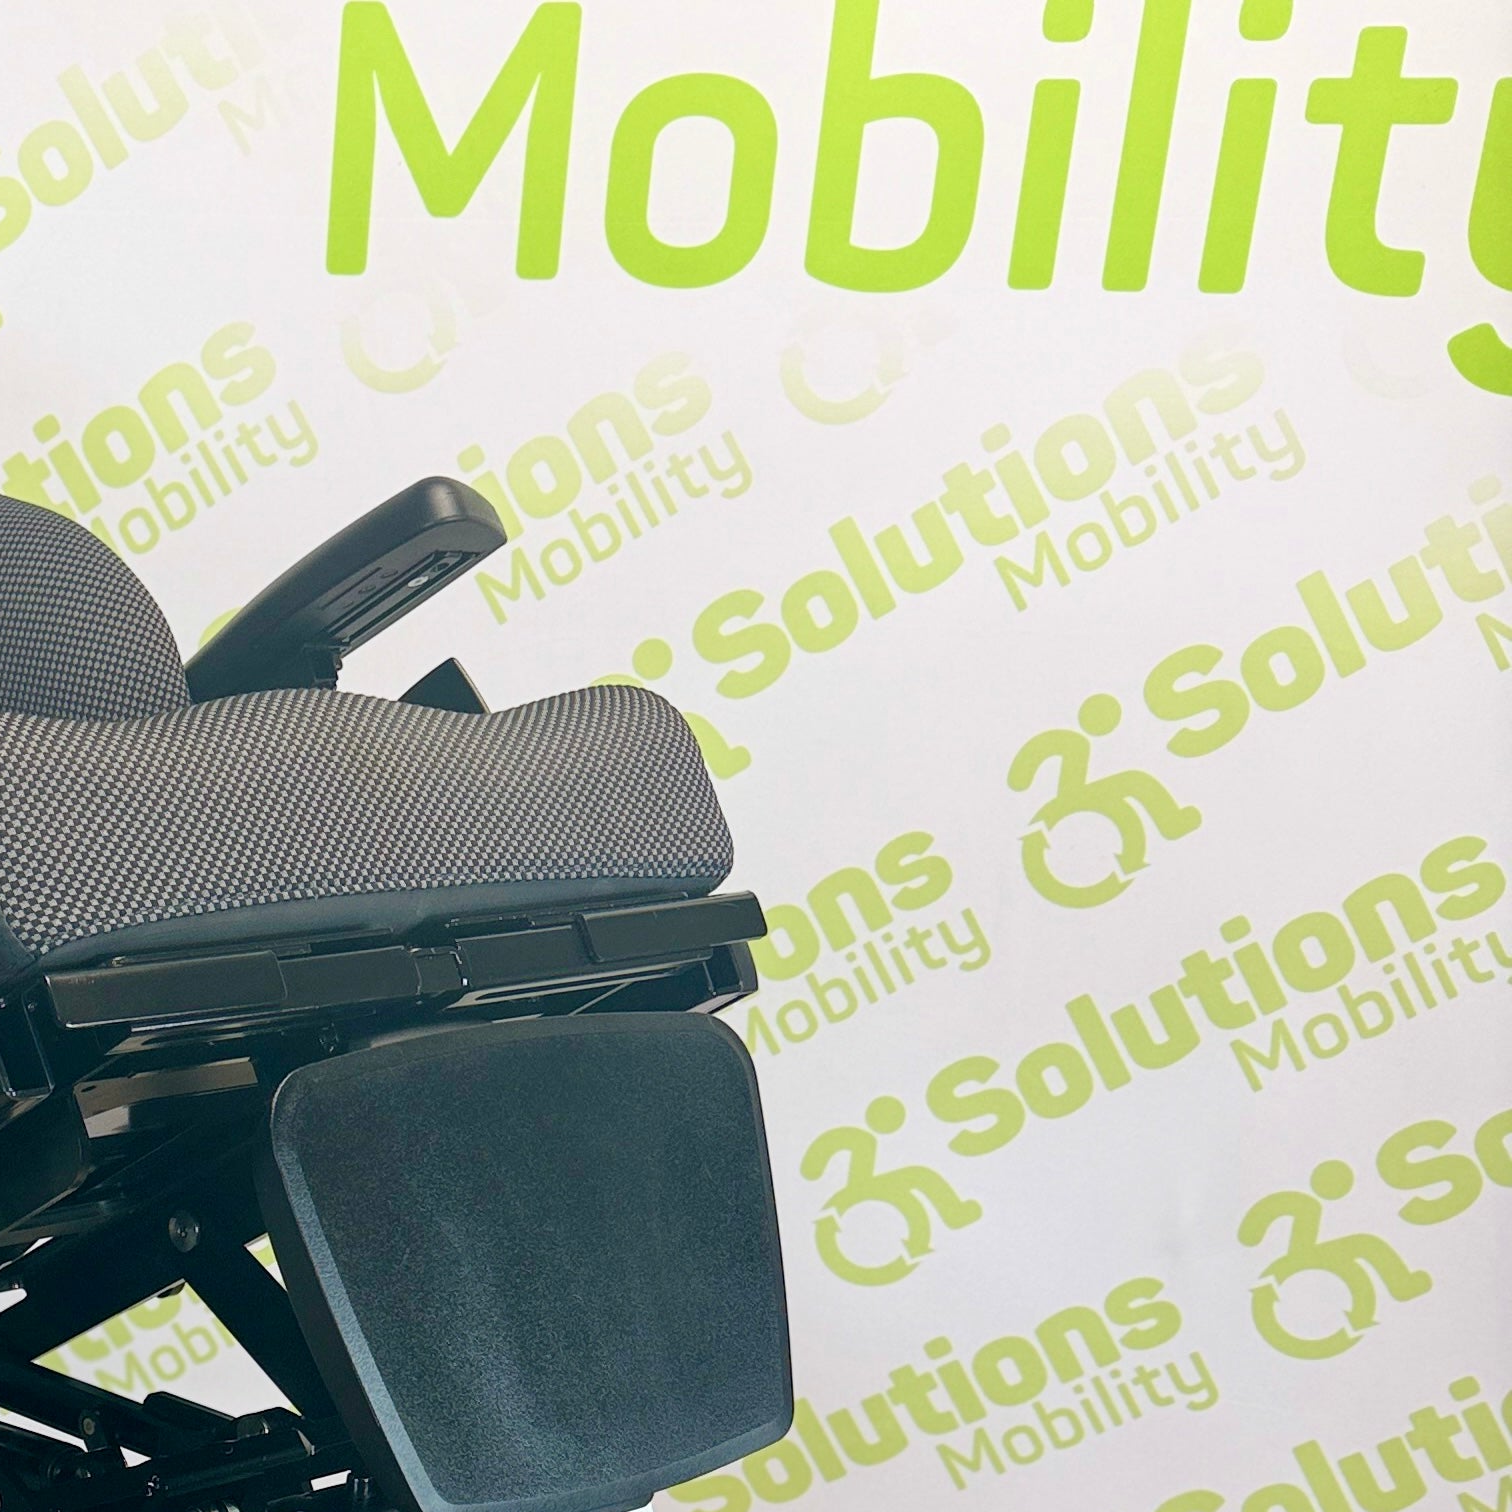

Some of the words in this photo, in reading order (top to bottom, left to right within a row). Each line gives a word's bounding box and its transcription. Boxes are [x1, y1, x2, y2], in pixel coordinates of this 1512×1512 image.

[473, 430, 754, 626] Mobility
[691, 320, 1266, 701] Solutions
[993, 408, 1307, 612] Mobility
[925, 835, 1507, 1158] Solutions
[934, 1352, 1220, 1491] Mobility
